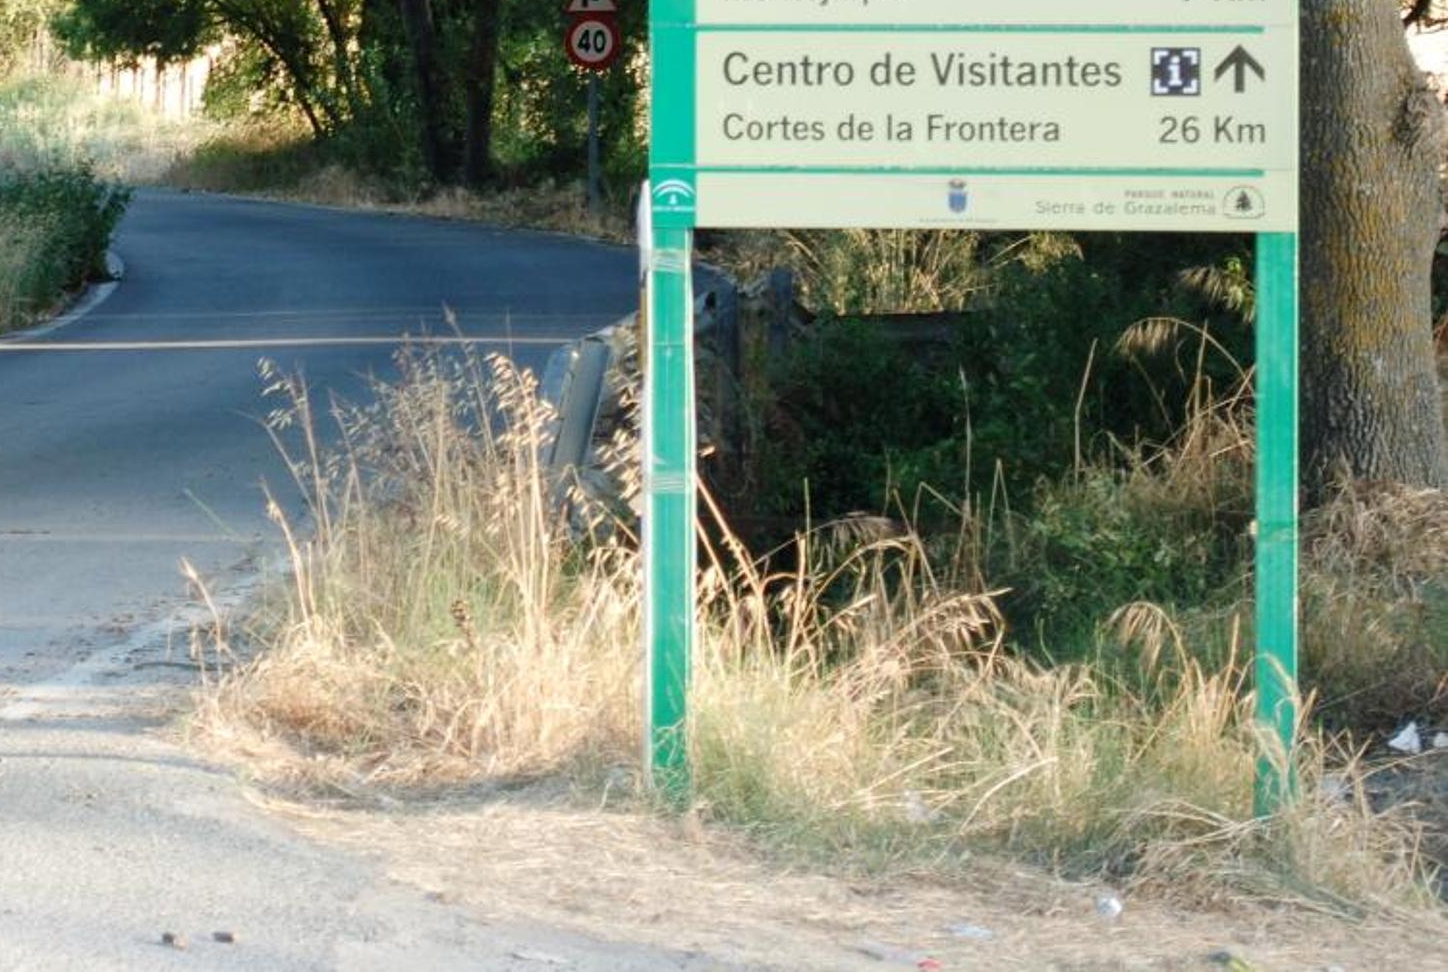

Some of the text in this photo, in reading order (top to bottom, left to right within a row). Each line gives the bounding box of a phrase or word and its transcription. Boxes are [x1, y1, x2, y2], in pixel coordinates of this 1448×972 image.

[577, 29, 607, 54] 40
[723, 51, 1122, 87] Centro de Visitantes
[722, 112, 1060, 142] Cortes de la Frontera
[1158, 115, 1266, 143] 26 Km
[1035, 201, 1216, 215] Sierra de Grazalema
